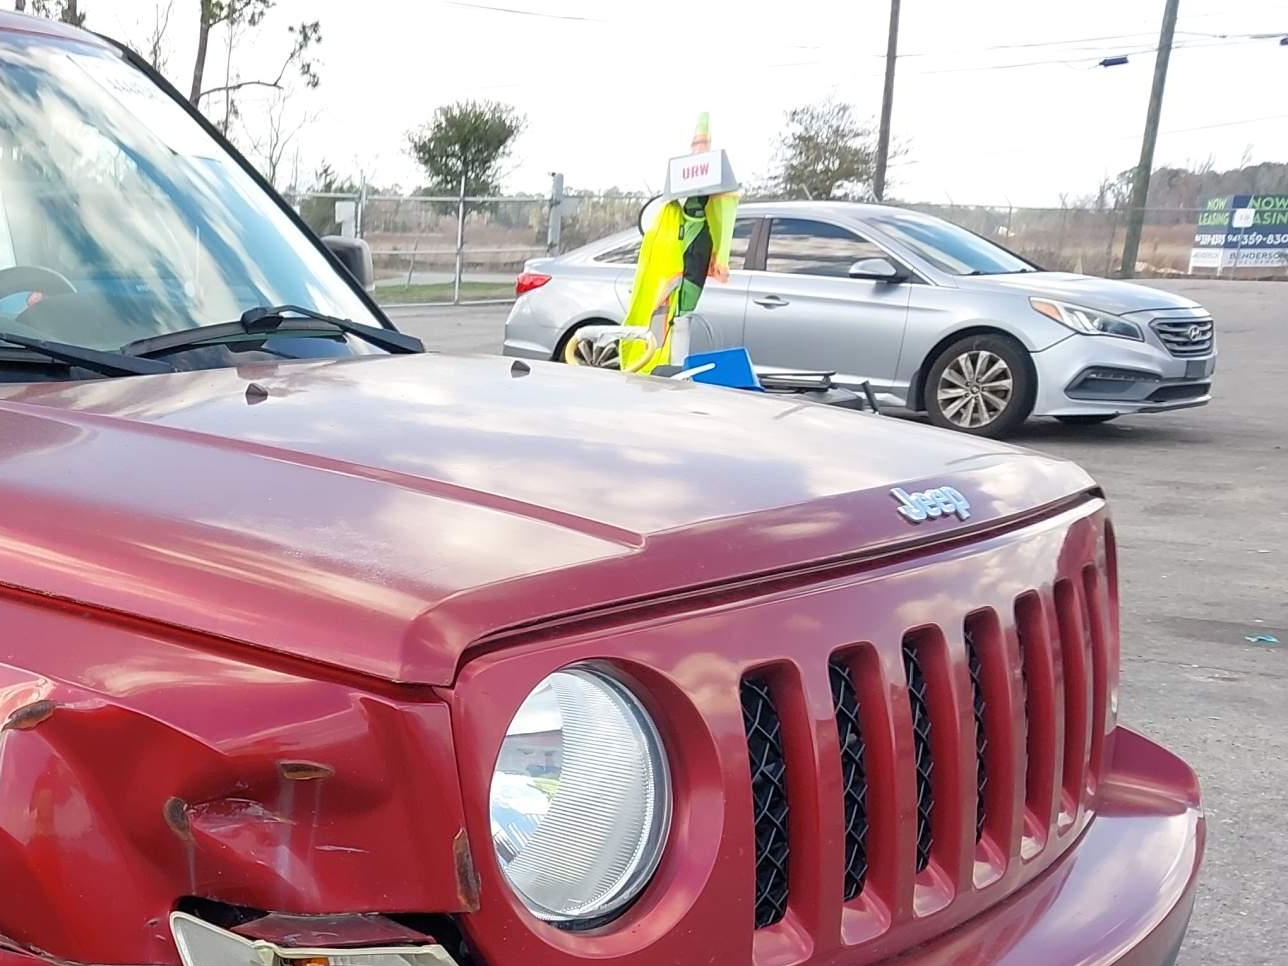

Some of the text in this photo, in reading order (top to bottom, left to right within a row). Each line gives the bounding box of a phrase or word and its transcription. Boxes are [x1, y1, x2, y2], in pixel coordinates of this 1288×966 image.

[682, 162, 710, 180] URW
[1207, 199, 1228, 211] NOW
[1252, 196, 1288, 210] NOW
[1198, 212, 1230, 226] LEASING
[890, 486, 971, 522] Jeep
